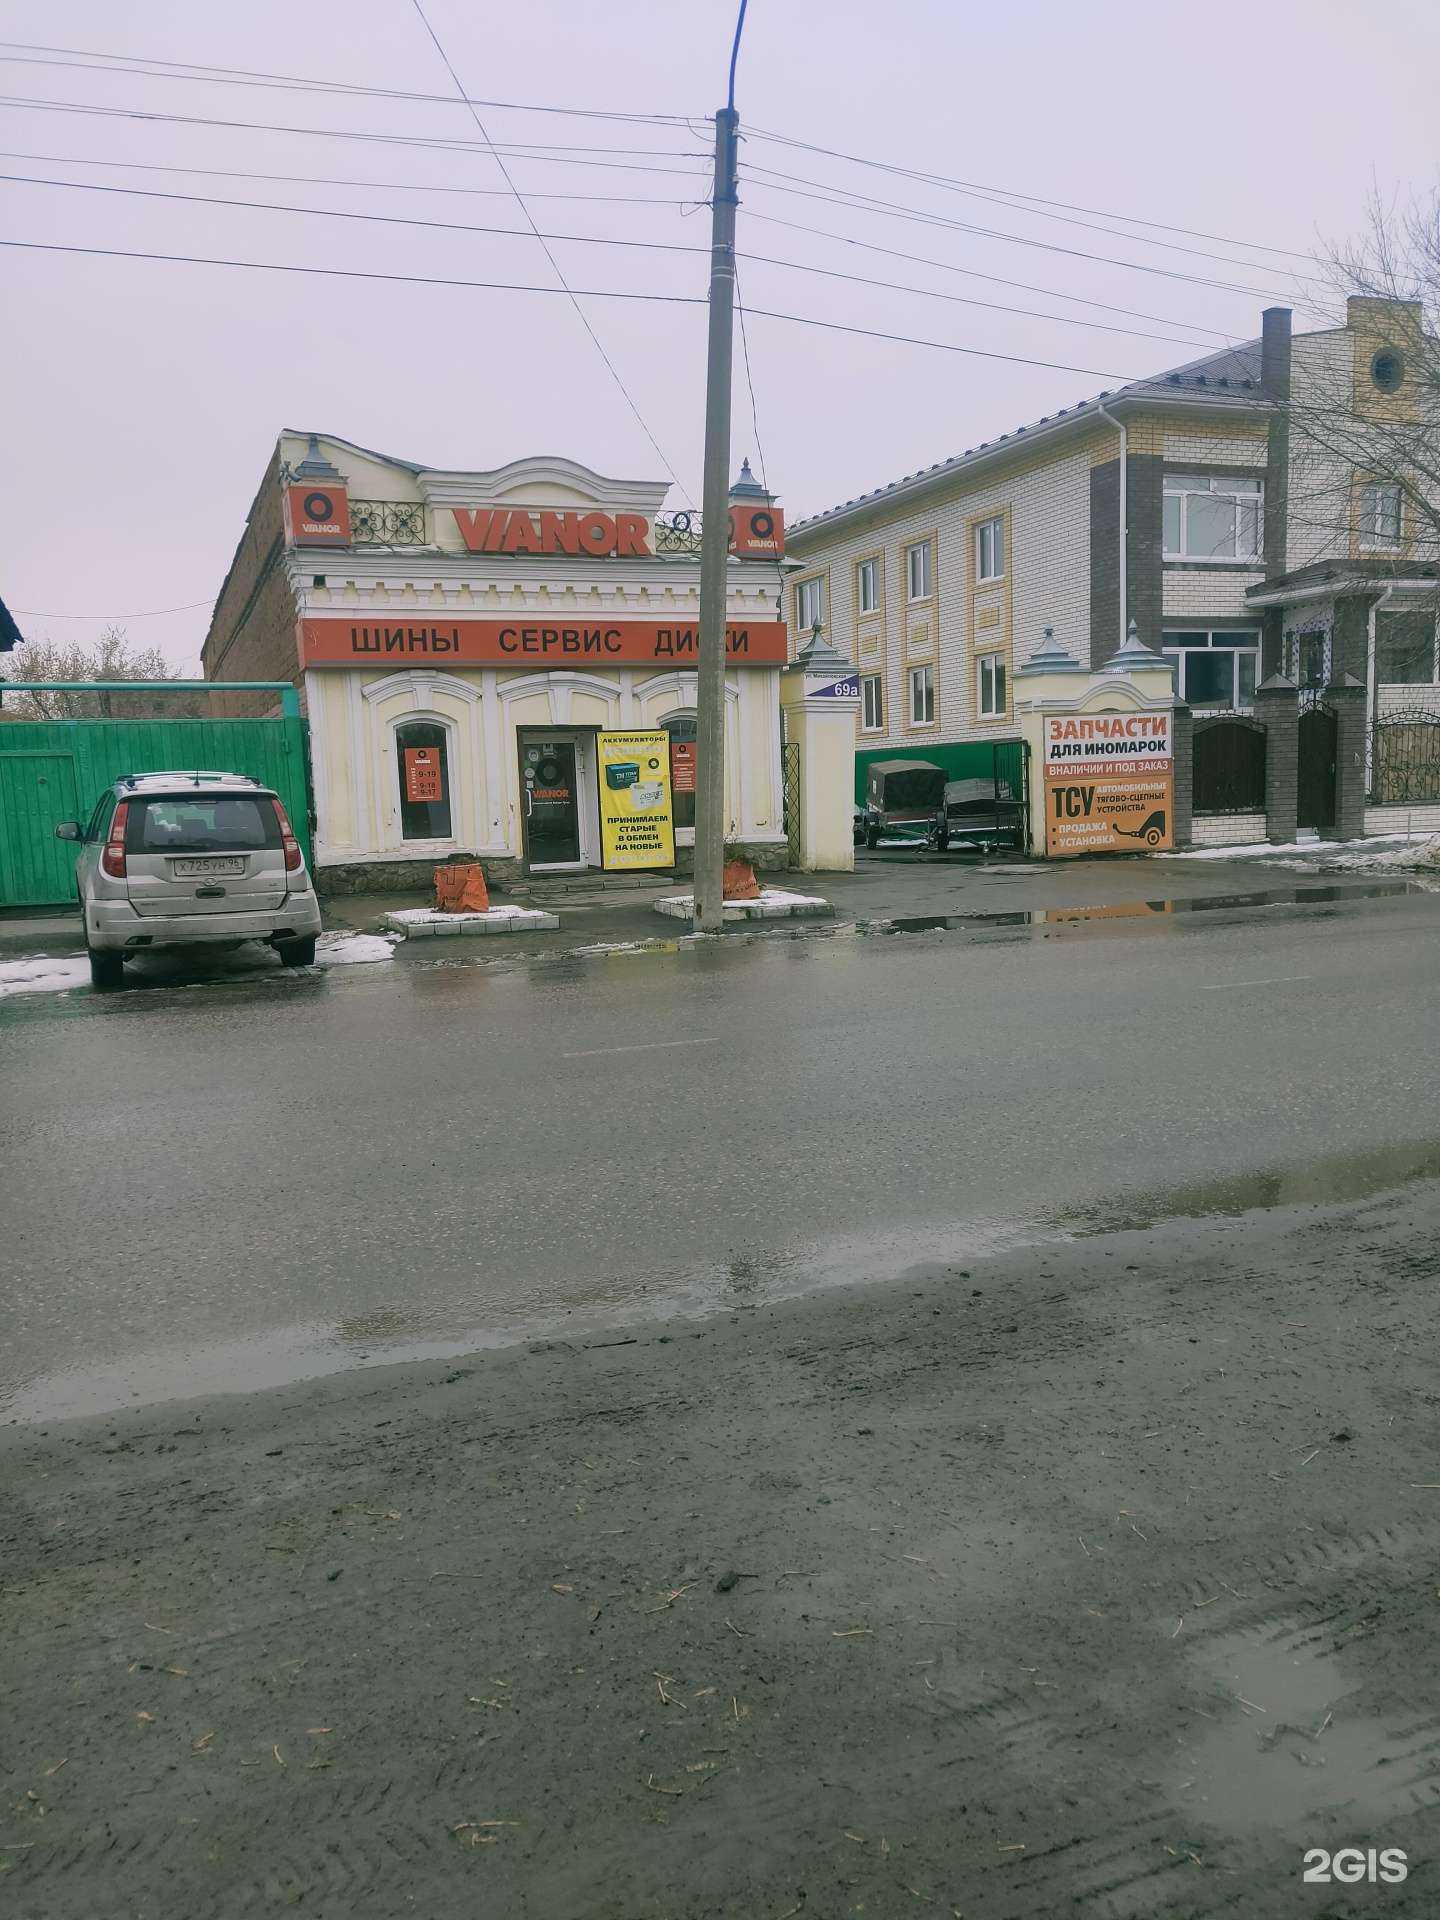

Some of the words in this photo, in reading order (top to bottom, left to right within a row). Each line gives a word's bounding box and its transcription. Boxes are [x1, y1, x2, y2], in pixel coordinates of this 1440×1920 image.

[452, 509, 650, 557] VIANOR
[351, 627, 460, 653] ШИНЫ
[498, 628, 623, 653] СЕРВИС
[654, 629, 749, 656] ДИИ
[1050, 716, 1167, 741] ЗАПЧАСТИ
[602, 735, 667, 744] АККУМУЛЯТОРЫ
[1050, 743, 1082, 759] ДЛЯ
[1084, 740, 1167, 755] ИНОМАРОК
[1105, 763, 1113, 773] И
[1115, 762, 1136, 774] ПОД
[1137, 760, 1168, 772] ЗАКАЗ
[1096, 782, 1167, 793] АВТОМОБИЛЬНЫЕ
[1052, 786, 1095, 818] ТСУ
[1096, 792, 1166, 803] ТЯГОВО-СЦЕПНЫЕ
[1096, 803, 1146, 813] УСТРОЙСТВА
[607, 815, 669, 824] ПРИНИМАЕМ
[619, 825, 657, 833] СТАРЫЕ
[1059, 822, 1107, 834] ПРОДАЖА
[618, 834, 624, 842] В
[627, 833, 659, 842] ОБМЕН
[1059, 834, 1116, 848] УСТАНОВКА
[615, 843, 629, 851] НА
[631, 842, 663, 851] НОВЫЕ
